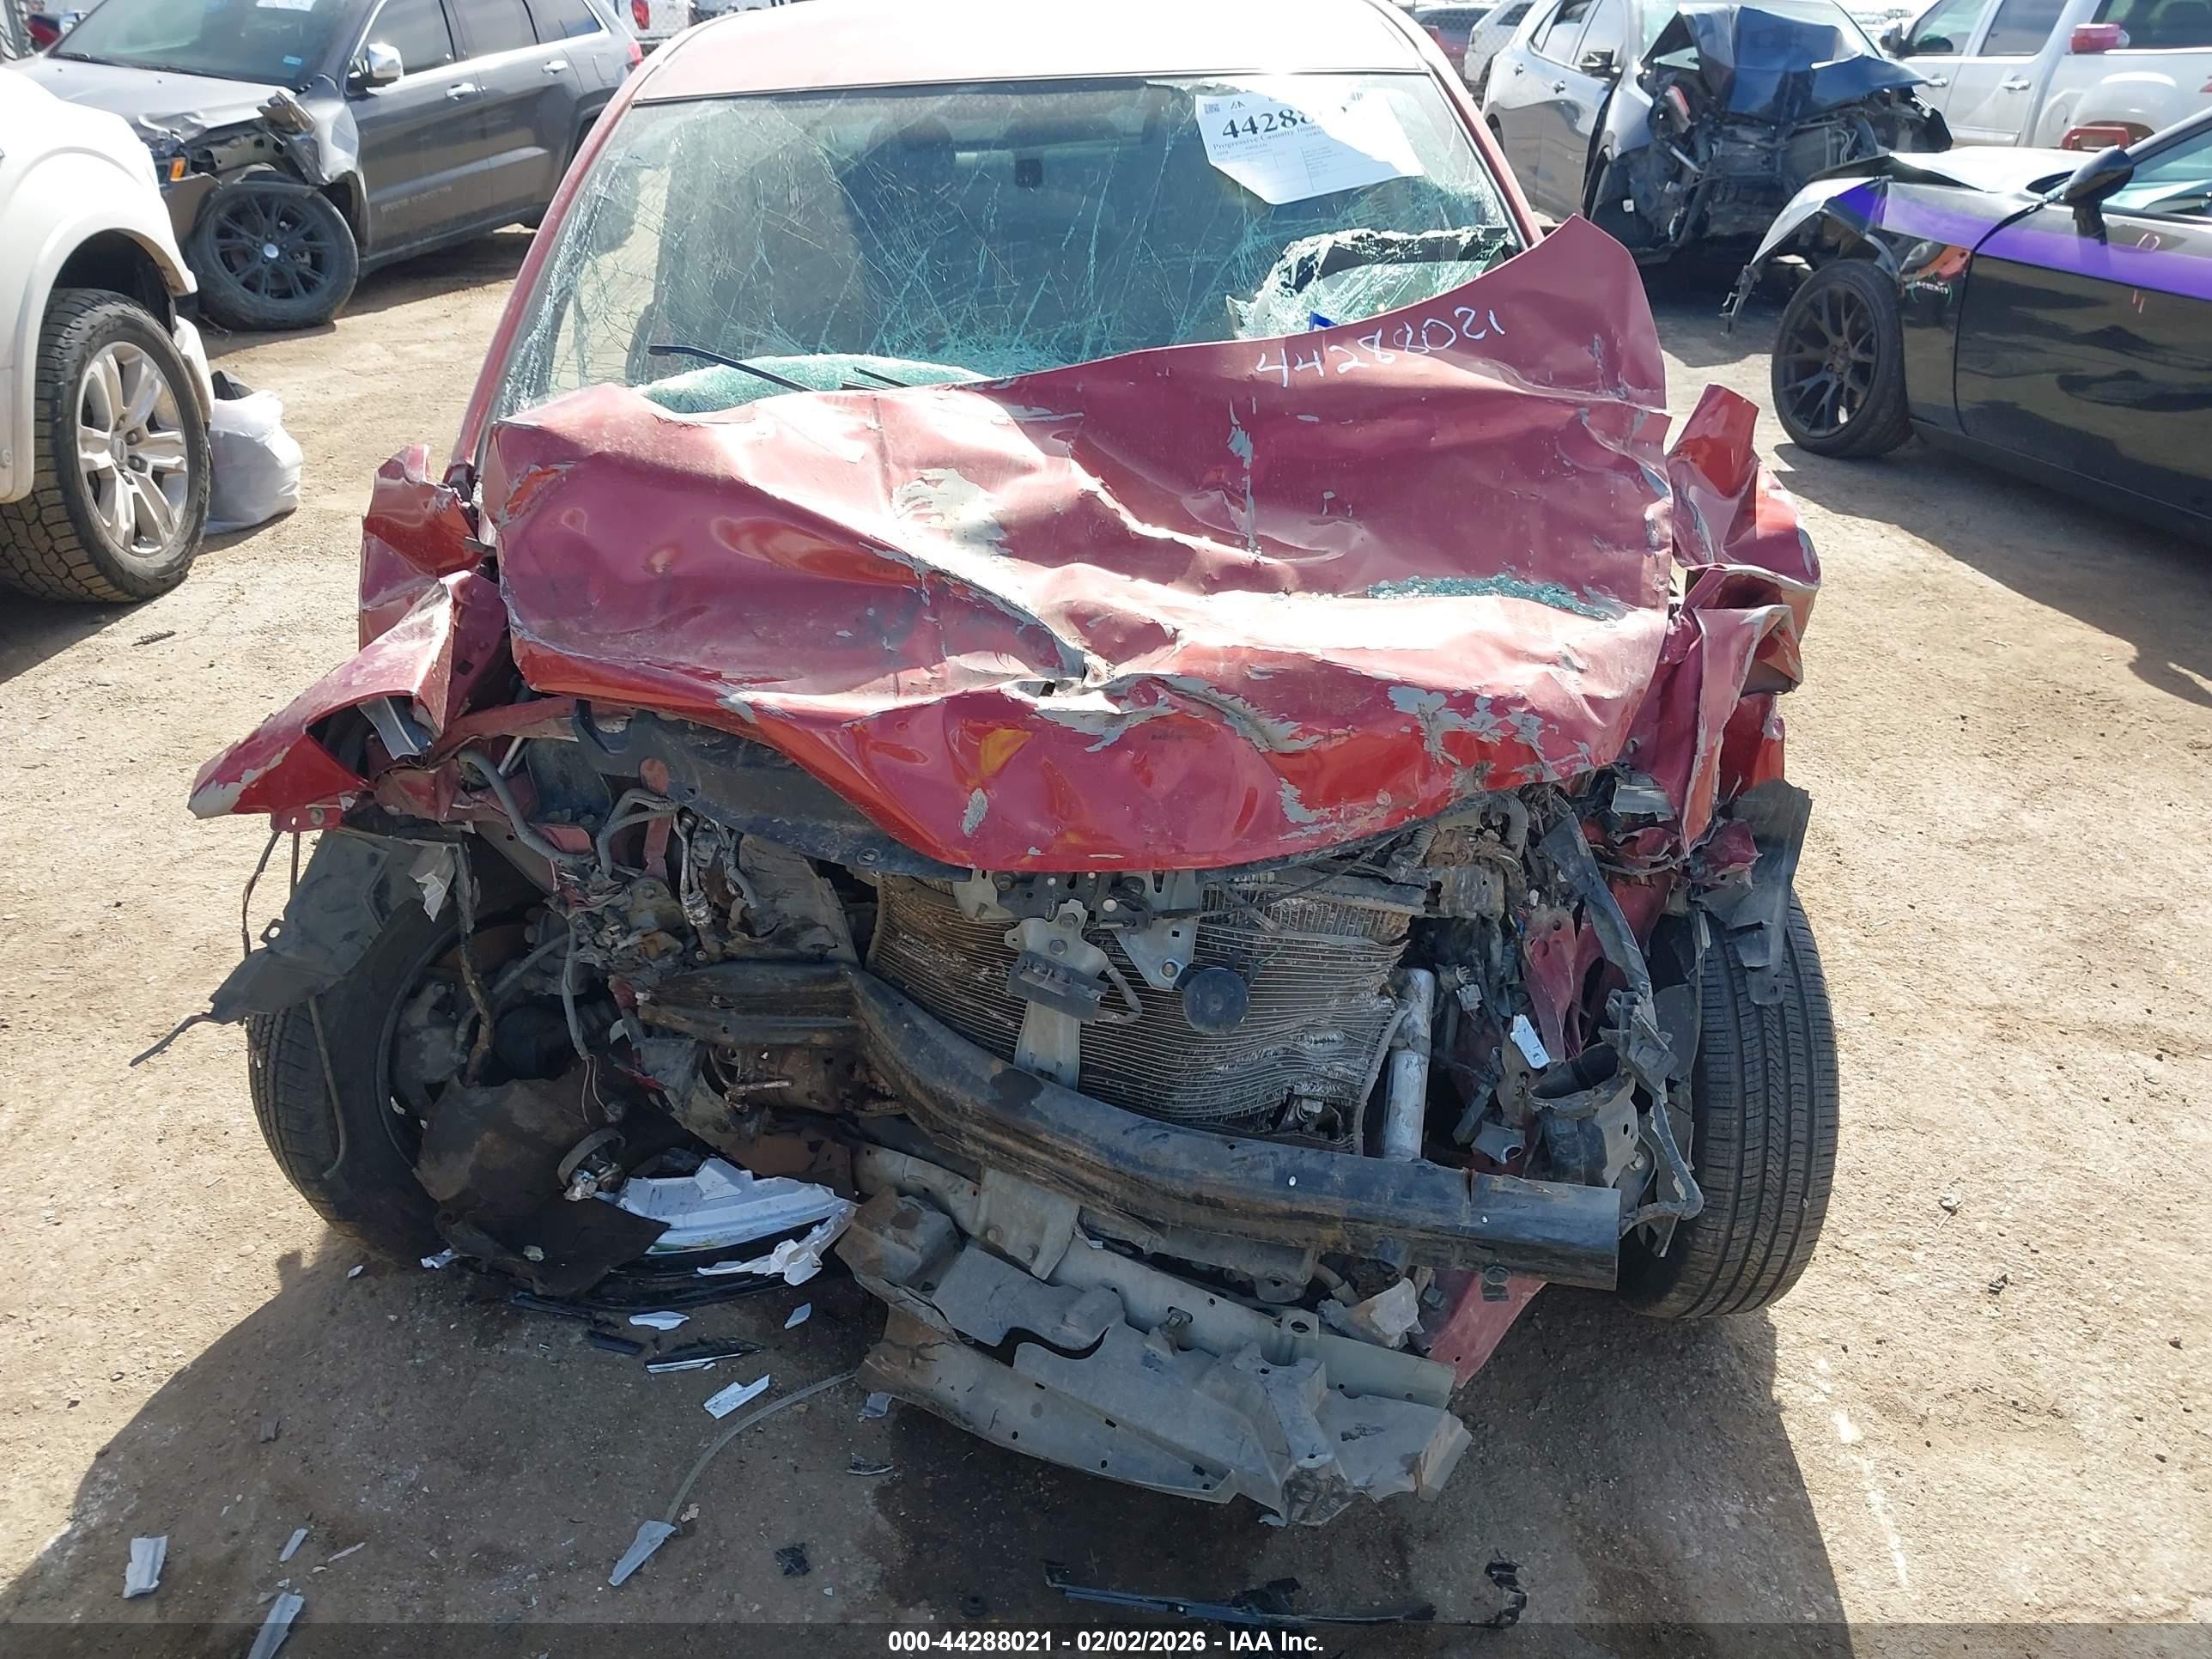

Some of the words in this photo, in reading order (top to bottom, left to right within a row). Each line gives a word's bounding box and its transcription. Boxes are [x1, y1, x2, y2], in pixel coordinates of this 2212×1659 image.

[1212, 135, 1259, 150] Progressive
[1260, 128, 1295, 143] Casualty
[1222, 108, 1317, 139] 44288
[1255, 306, 1506, 388] 44288021
